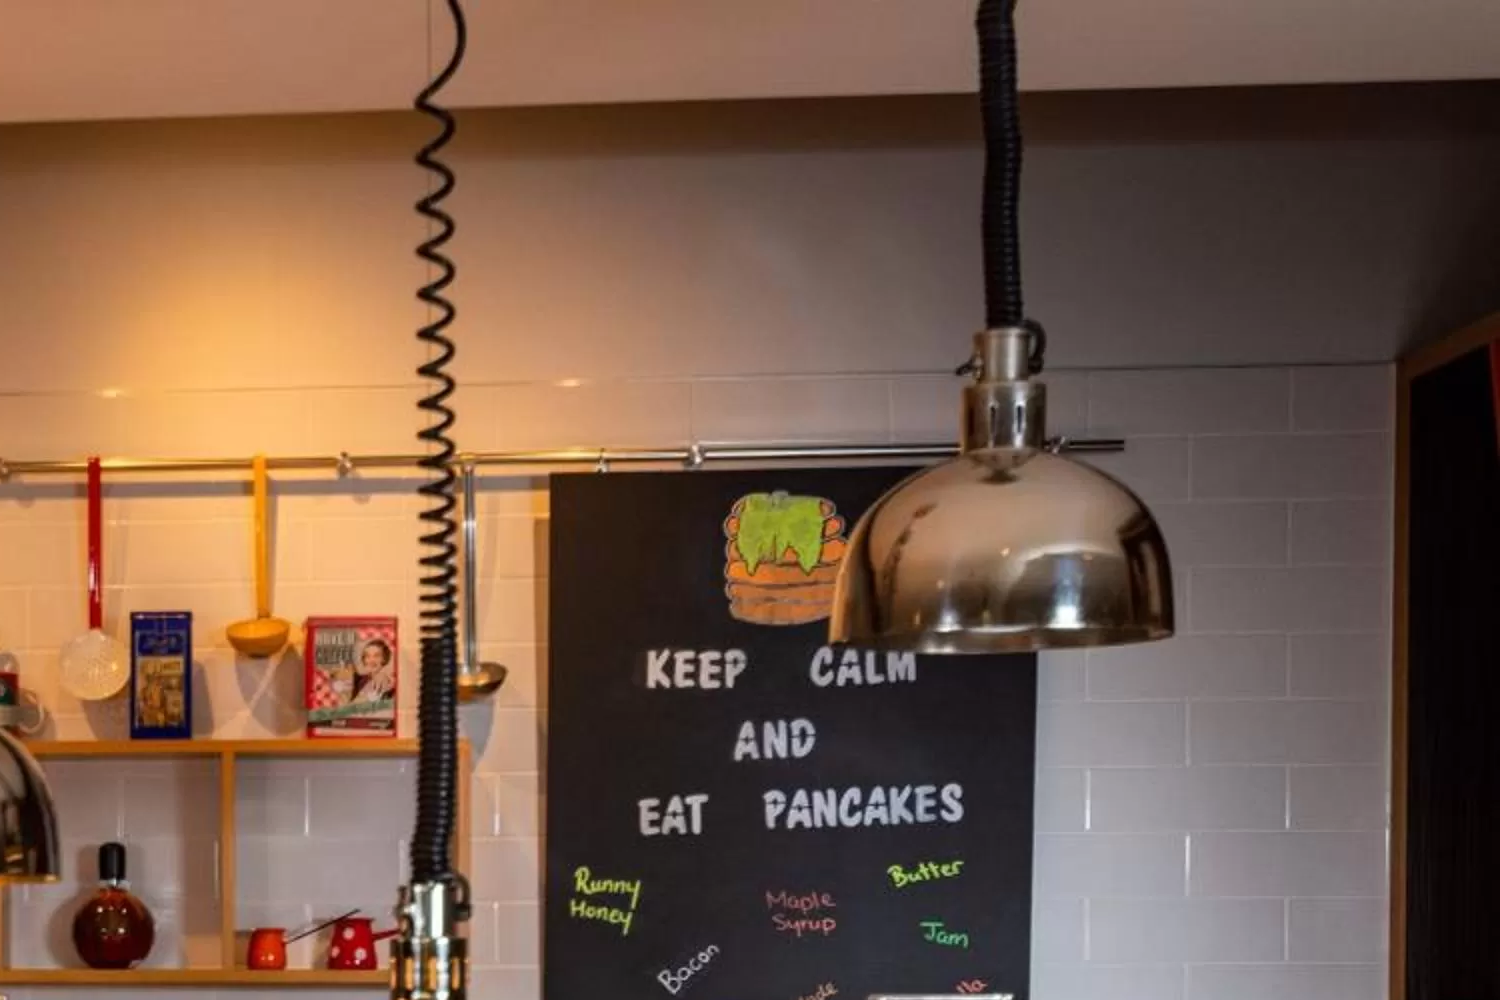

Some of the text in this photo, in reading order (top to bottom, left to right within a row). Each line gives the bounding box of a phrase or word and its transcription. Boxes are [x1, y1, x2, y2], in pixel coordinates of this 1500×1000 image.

[646, 647, 918, 689] KEEP CALM
[733, 718, 816, 761] AND
[638, 783, 964, 836] EAT PANCAKES
[574, 866, 641, 907] Runny
[887, 860, 964, 887] Butter
[570, 900, 633, 935] Honey
[765, 891, 836, 915] Maple
[772, 915, 837, 937] Syrup
[919, 921, 969, 948] Jam
[657, 944, 720, 995] Bacon
